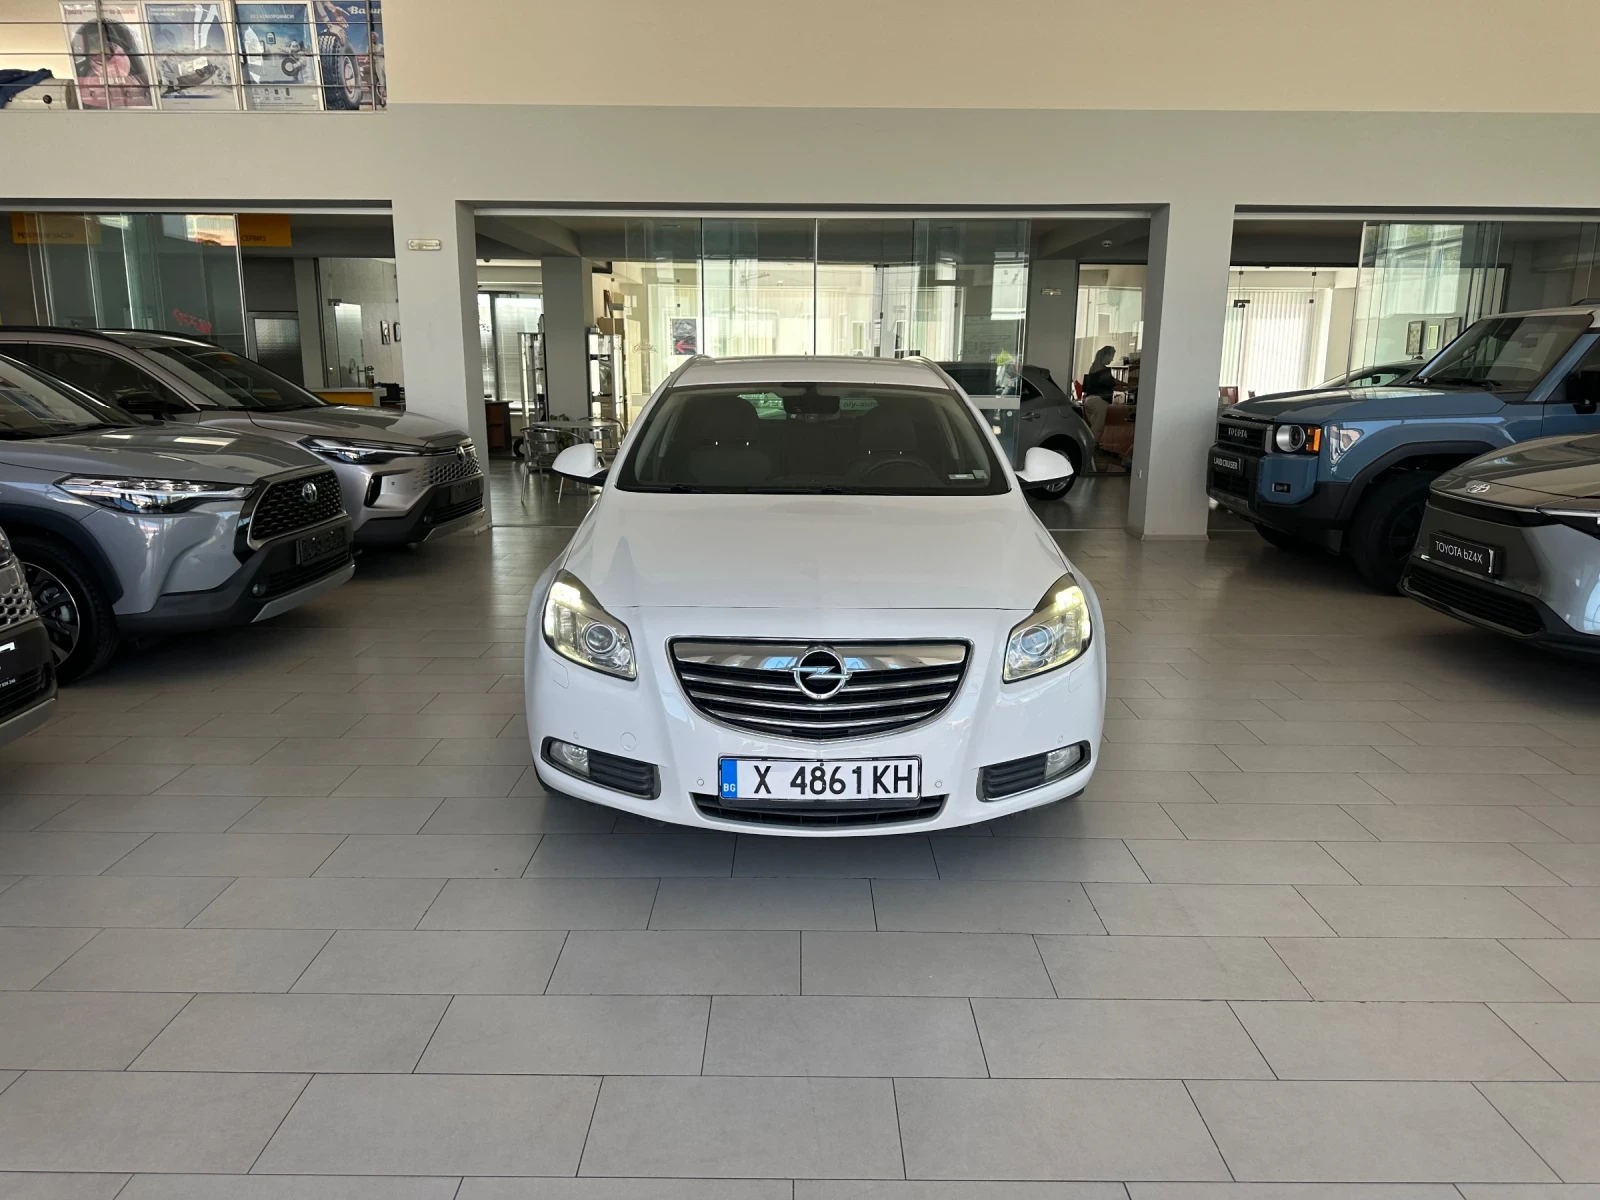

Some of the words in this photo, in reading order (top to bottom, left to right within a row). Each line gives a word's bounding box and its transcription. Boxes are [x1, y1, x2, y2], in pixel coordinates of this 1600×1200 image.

[1228, 427, 1248, 439] TOYOTA
[1213, 456, 1223, 466] LAND
[1223, 458, 1238, 470] CRUISER
[1435, 541, 1462, 558] TOYOTA
[1463, 549, 1483, 564] bZ4X
[753, 765, 772, 794] X
[789, 765, 863, 795] 4861
[723, 783, 737, 792] BG
